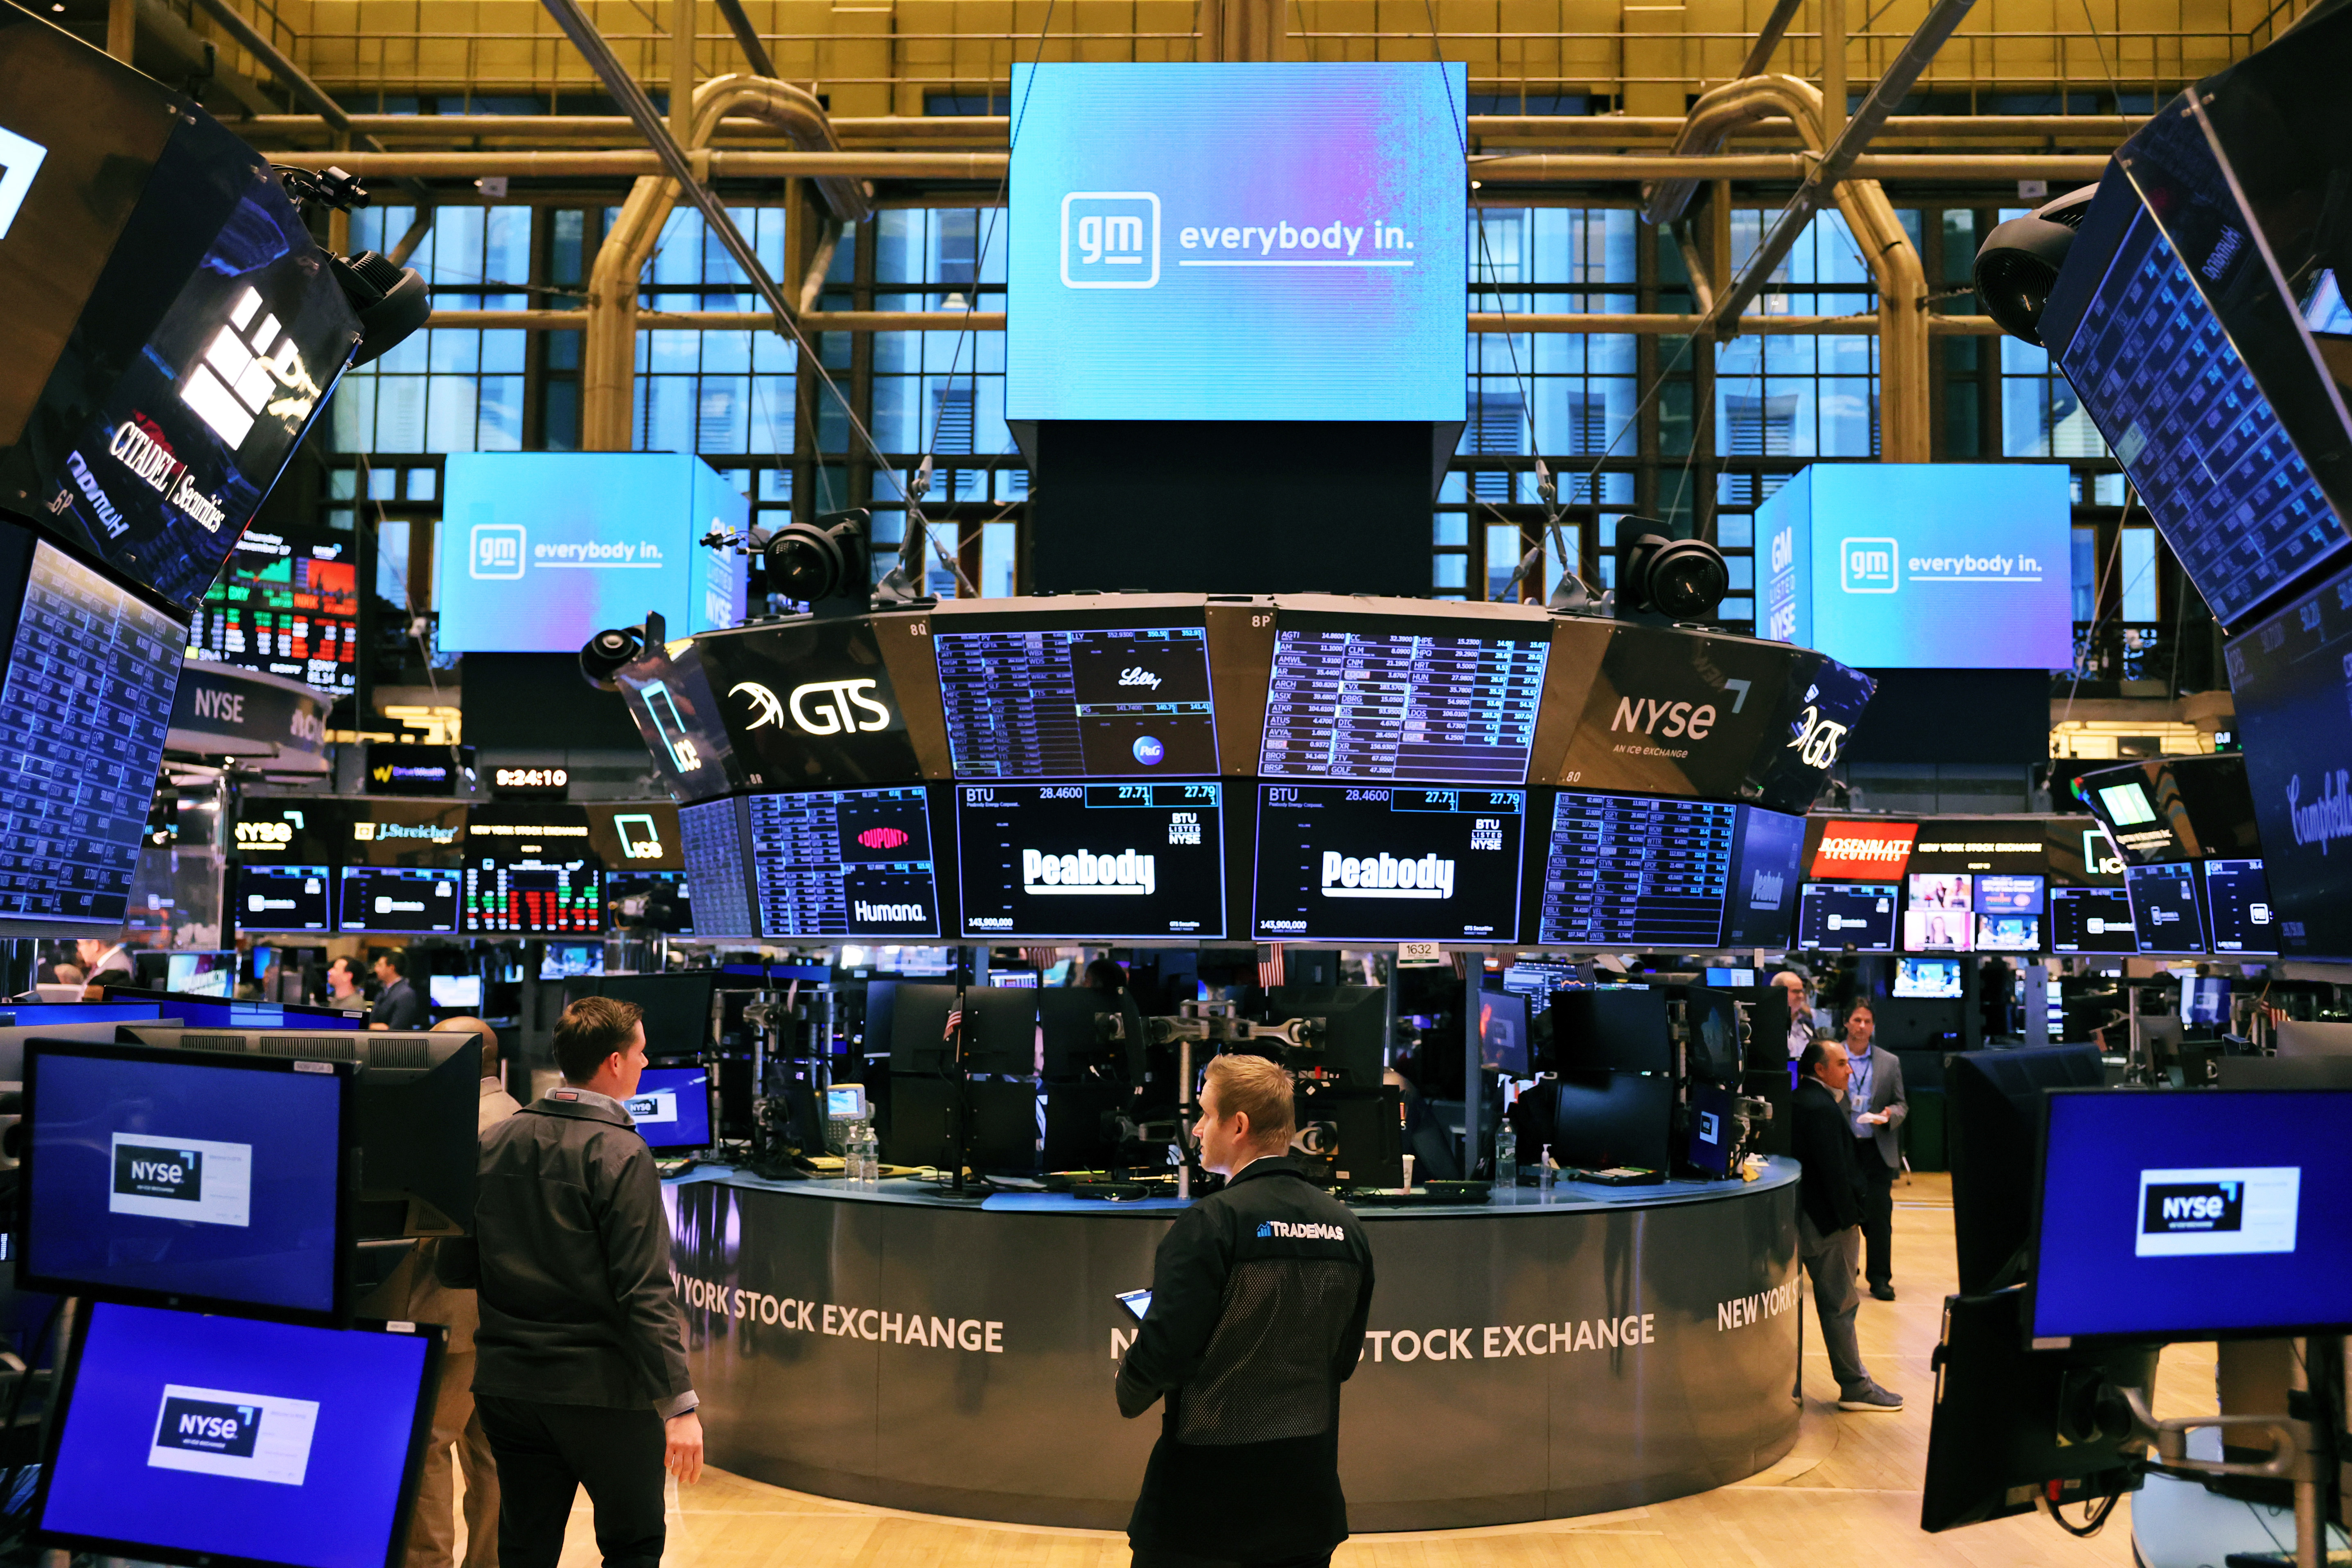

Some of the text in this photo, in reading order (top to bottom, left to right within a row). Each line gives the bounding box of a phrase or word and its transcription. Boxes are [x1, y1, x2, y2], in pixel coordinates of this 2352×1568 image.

[1079, 215, 1142, 264] gm
[1180, 220, 1414, 255] everybody in.
[110, 421, 226, 533] CITADEL Securities
[480, 537, 516, 566] gm
[535, 541, 663, 561] everybody in.
[1772, 526, 1792, 573] GM
[1851, 551, 1889, 580] gm
[1909, 554, 2043, 575] everybody in.
[910, 623, 927, 636] 8Q
[1252, 615, 1271, 627] 8P
[1118, 666, 1162, 691] Lilly
[194, 688, 244, 723] NYSE
[790, 679, 890, 735] GTS
[1802, 720, 1847, 769] GTS
[2214, 732, 2231, 744] DJI
[1140, 745, 1160, 756] P&G
[1613, 745, 1625, 753] AN
[497, 769, 567, 786] 9:24:10
[966, 786, 1216, 802] BTU 28.4600 27.71 27.79
[1269, 787, 1520, 805] BTU 28.4600 27.71 27.79
[1172, 813, 1197, 823] BTU
[1476, 819, 1499, 830] BTU
[863, 827, 903, 849] DUPONT
[1169, 835, 1201, 844] NYSE
[1471, 840, 1501, 850] NYSE
[1818, 837, 1912, 855] ROSENBLATT
[1919, 843, 2042, 852] NEW YORK STOCK EXCHANGE
[1824, 852, 1901, 862] SECURITIES
[1023, 848, 1155, 895] Peabody
[1322, 851, 1454, 898] Peabody
[854, 900, 927, 922] Humana.
[968, 918, 1013, 927] 143,900,000
[1260, 920, 1307, 930] 143,900,000
[1406, 944, 1431, 954] 1632
[1270, 1221, 1345, 1241] TRADEMAS
[683, 1275, 730, 1315] YORK
[734, 1288, 815, 1333] STOCK
[822, 1304, 1004, 1353] EXCHANGE
[1718, 1293, 1759, 1332] NEW
[1760, 1282, 1792, 1320] YORK
[1358, 1313, 1655, 1362] TOCK EXCHANGE
